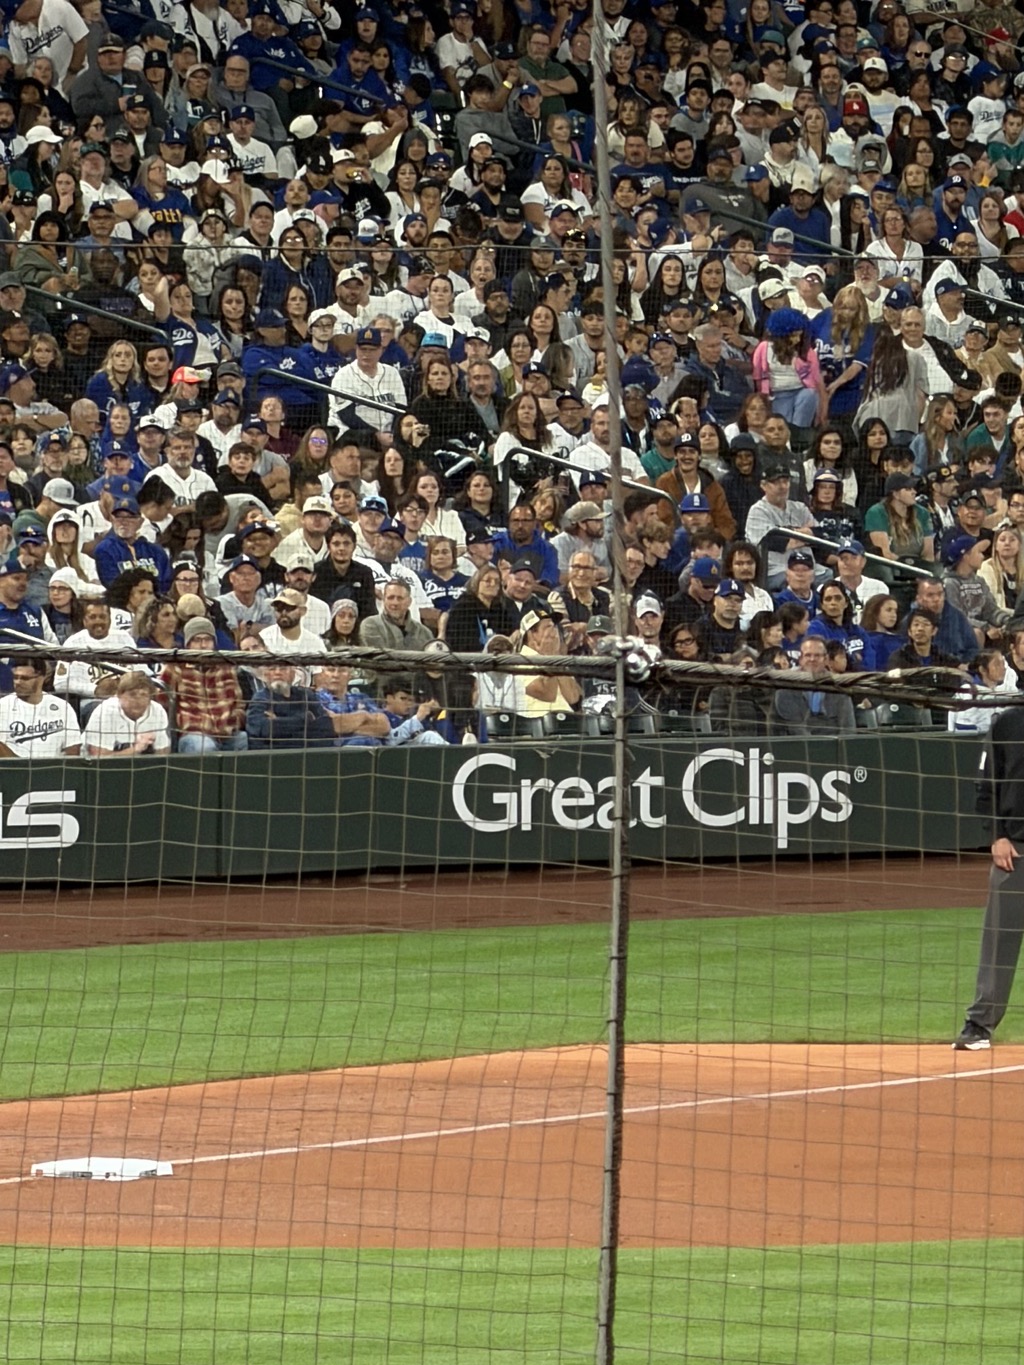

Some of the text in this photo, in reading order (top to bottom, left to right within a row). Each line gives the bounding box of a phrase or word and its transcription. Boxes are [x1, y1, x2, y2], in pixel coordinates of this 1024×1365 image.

[9, 719, 64, 743] Dodgers
[0, 790, 80, 849] S
[452, 752, 667, 832] Great
